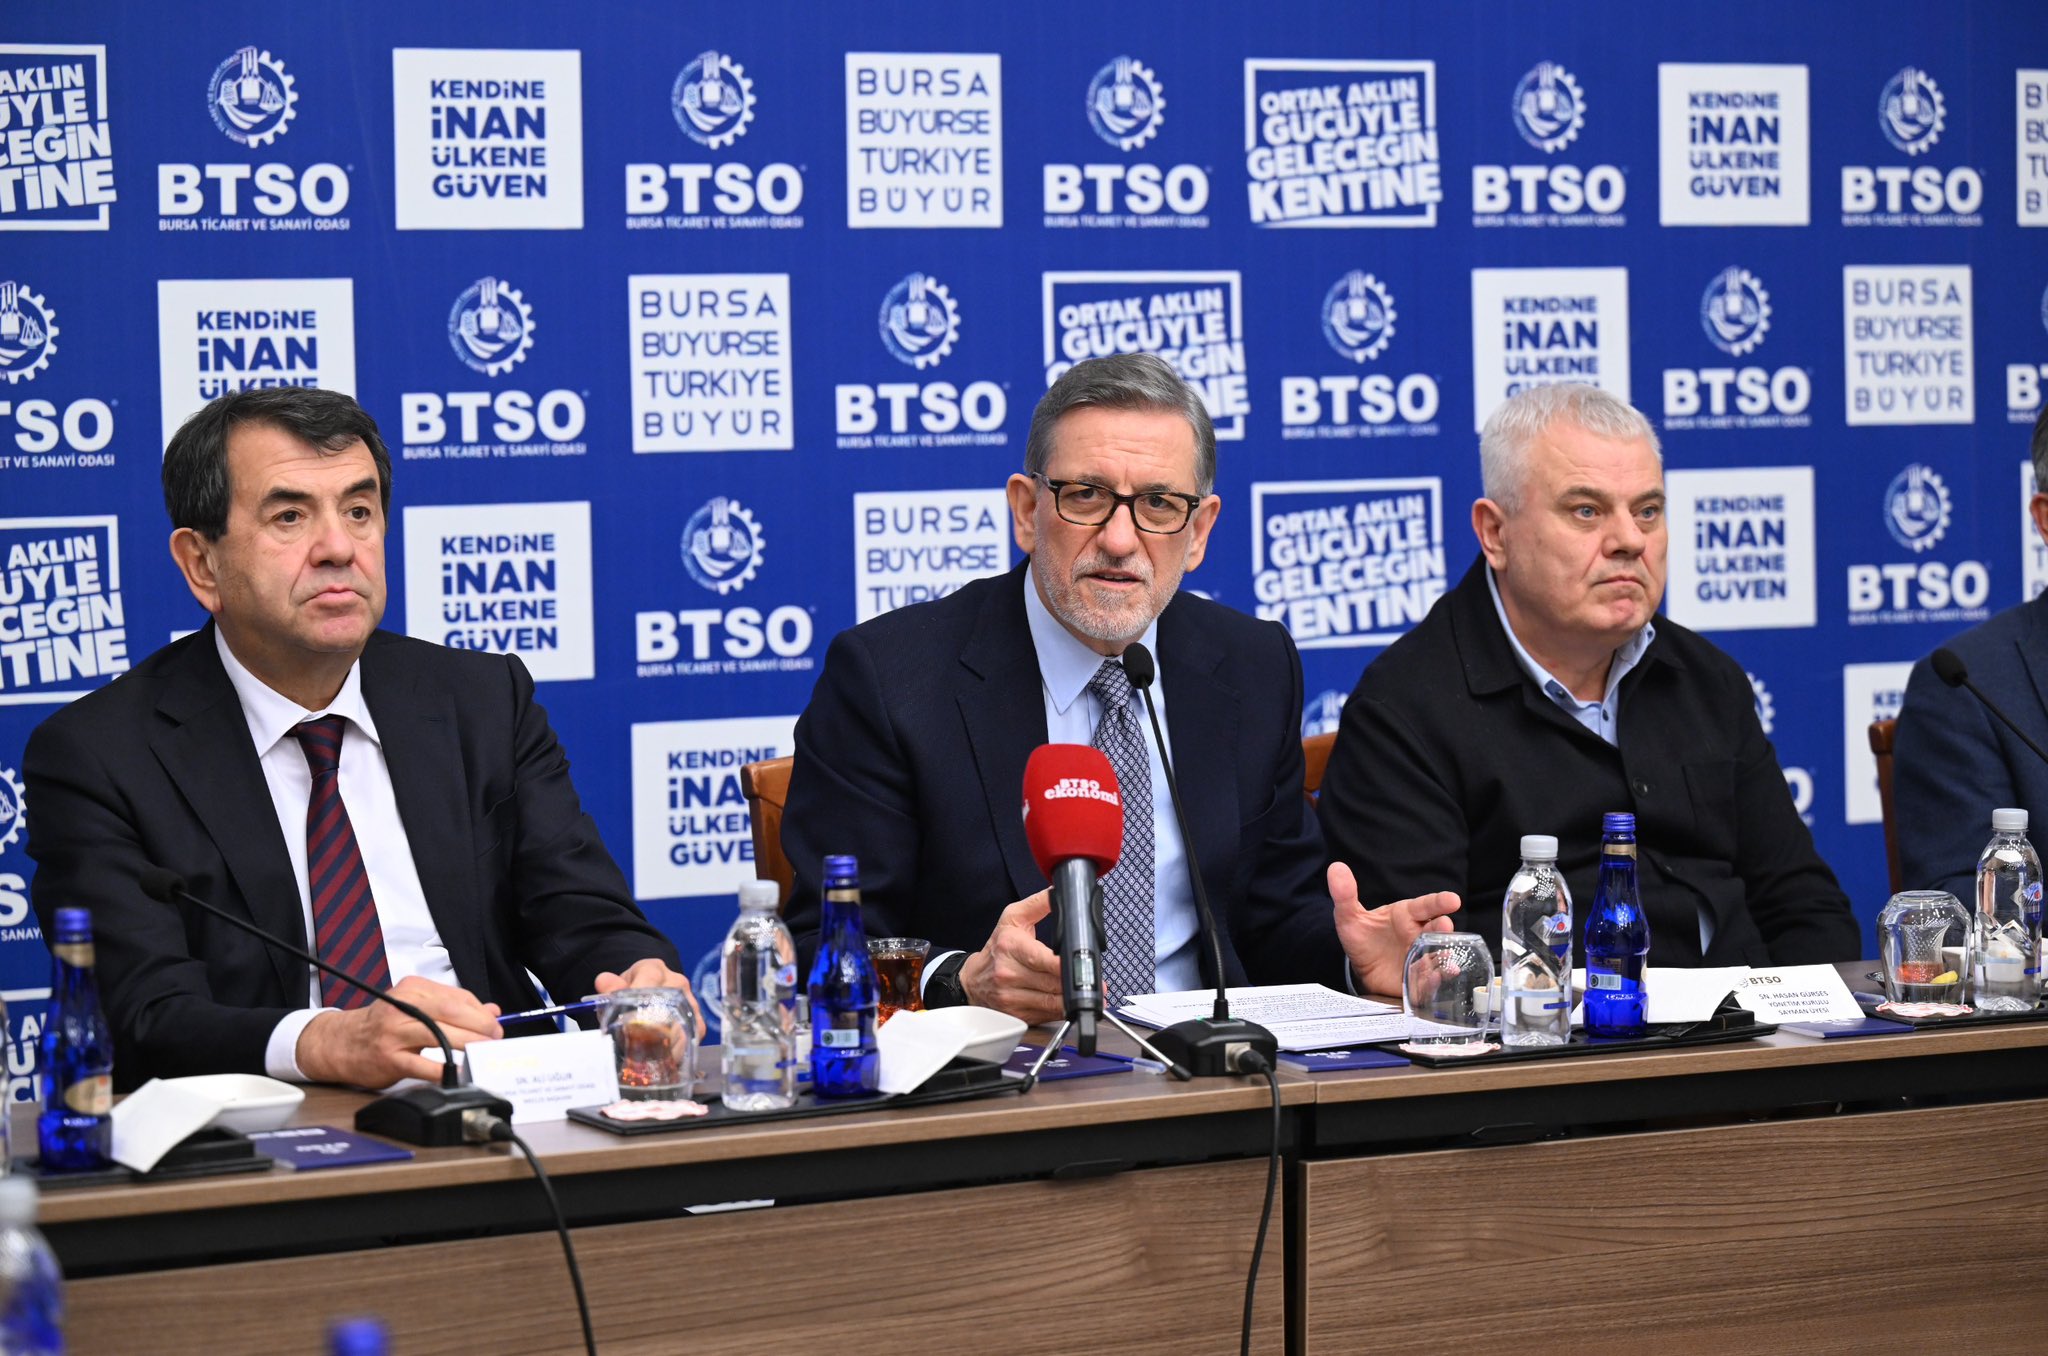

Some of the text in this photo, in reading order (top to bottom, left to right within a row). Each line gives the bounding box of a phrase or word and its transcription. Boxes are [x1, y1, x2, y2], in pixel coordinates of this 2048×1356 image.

[857, 68, 988, 97] BURSA
[1260, 77, 1418, 116] ORTAK AKLIN
[858, 108, 990, 135] BÜYÜRSE
[432, 146, 546, 168] ÜLKENE
[159, 164, 349, 215] BTSO
[432, 173, 547, 198] GÜVEN
[626, 163, 802, 214] BTSO
[858, 187, 991, 214] BÜYÜR
[1044, 165, 1208, 213] BTSO
[1472, 165, 1626, 214] BTSO
[1841, 166, 1982, 215] BTSO
[158, 219, 198, 231] BURSA
[251, 219, 267, 230] VE
[314, 219, 350, 230] ODASI
[640, 289, 777, 319] BURSA
[1852, 278, 1962, 306] BURSA
[1058, 288, 1224, 329] ORTAK AKLIN
[642, 330, 779, 358] BÜYÜRSE
[1281, 374, 1439, 425] BTSO
[1663, 366, 1810, 417] BTSO
[402, 390, 585, 445] BTSO
[836, 382, 1006, 433] BTSO
[643, 409, 781, 438] BÜYÜR
[13, 456, 29, 468] VE
[31, 453, 76, 467] SANAYİ
[77, 454, 115, 467] ODASI
[402, 446, 441, 460] BURSA
[492, 445, 507, 457] VE
[551, 442, 587, 455] ODASI
[865, 505, 997, 536] BURSA
[1267, 494, 1425, 540] ORTAK AKLIN
[7, 534, 98, 570] AKLIN
[866, 544, 998, 574] BÜYÜRSE
[867, 585, 950, 612] TÜRK
[1847, 561, 1989, 612] BTSO
[443, 599, 557, 624] ÜLKENE
[444, 626, 558, 652] GÜVEN
[636, 606, 812, 663] BTSO
[0, 628, 130, 690] TİNE
[668, 774, 746, 809] İNA
[1044, 784, 1119, 806] ekonomi
[1059, 778, 1100, 790] BTSO
[669, 813, 752, 836] ÜLKEN
[669, 839, 755, 866] GÜVE
[1749, 976, 1782, 985] BTSO
